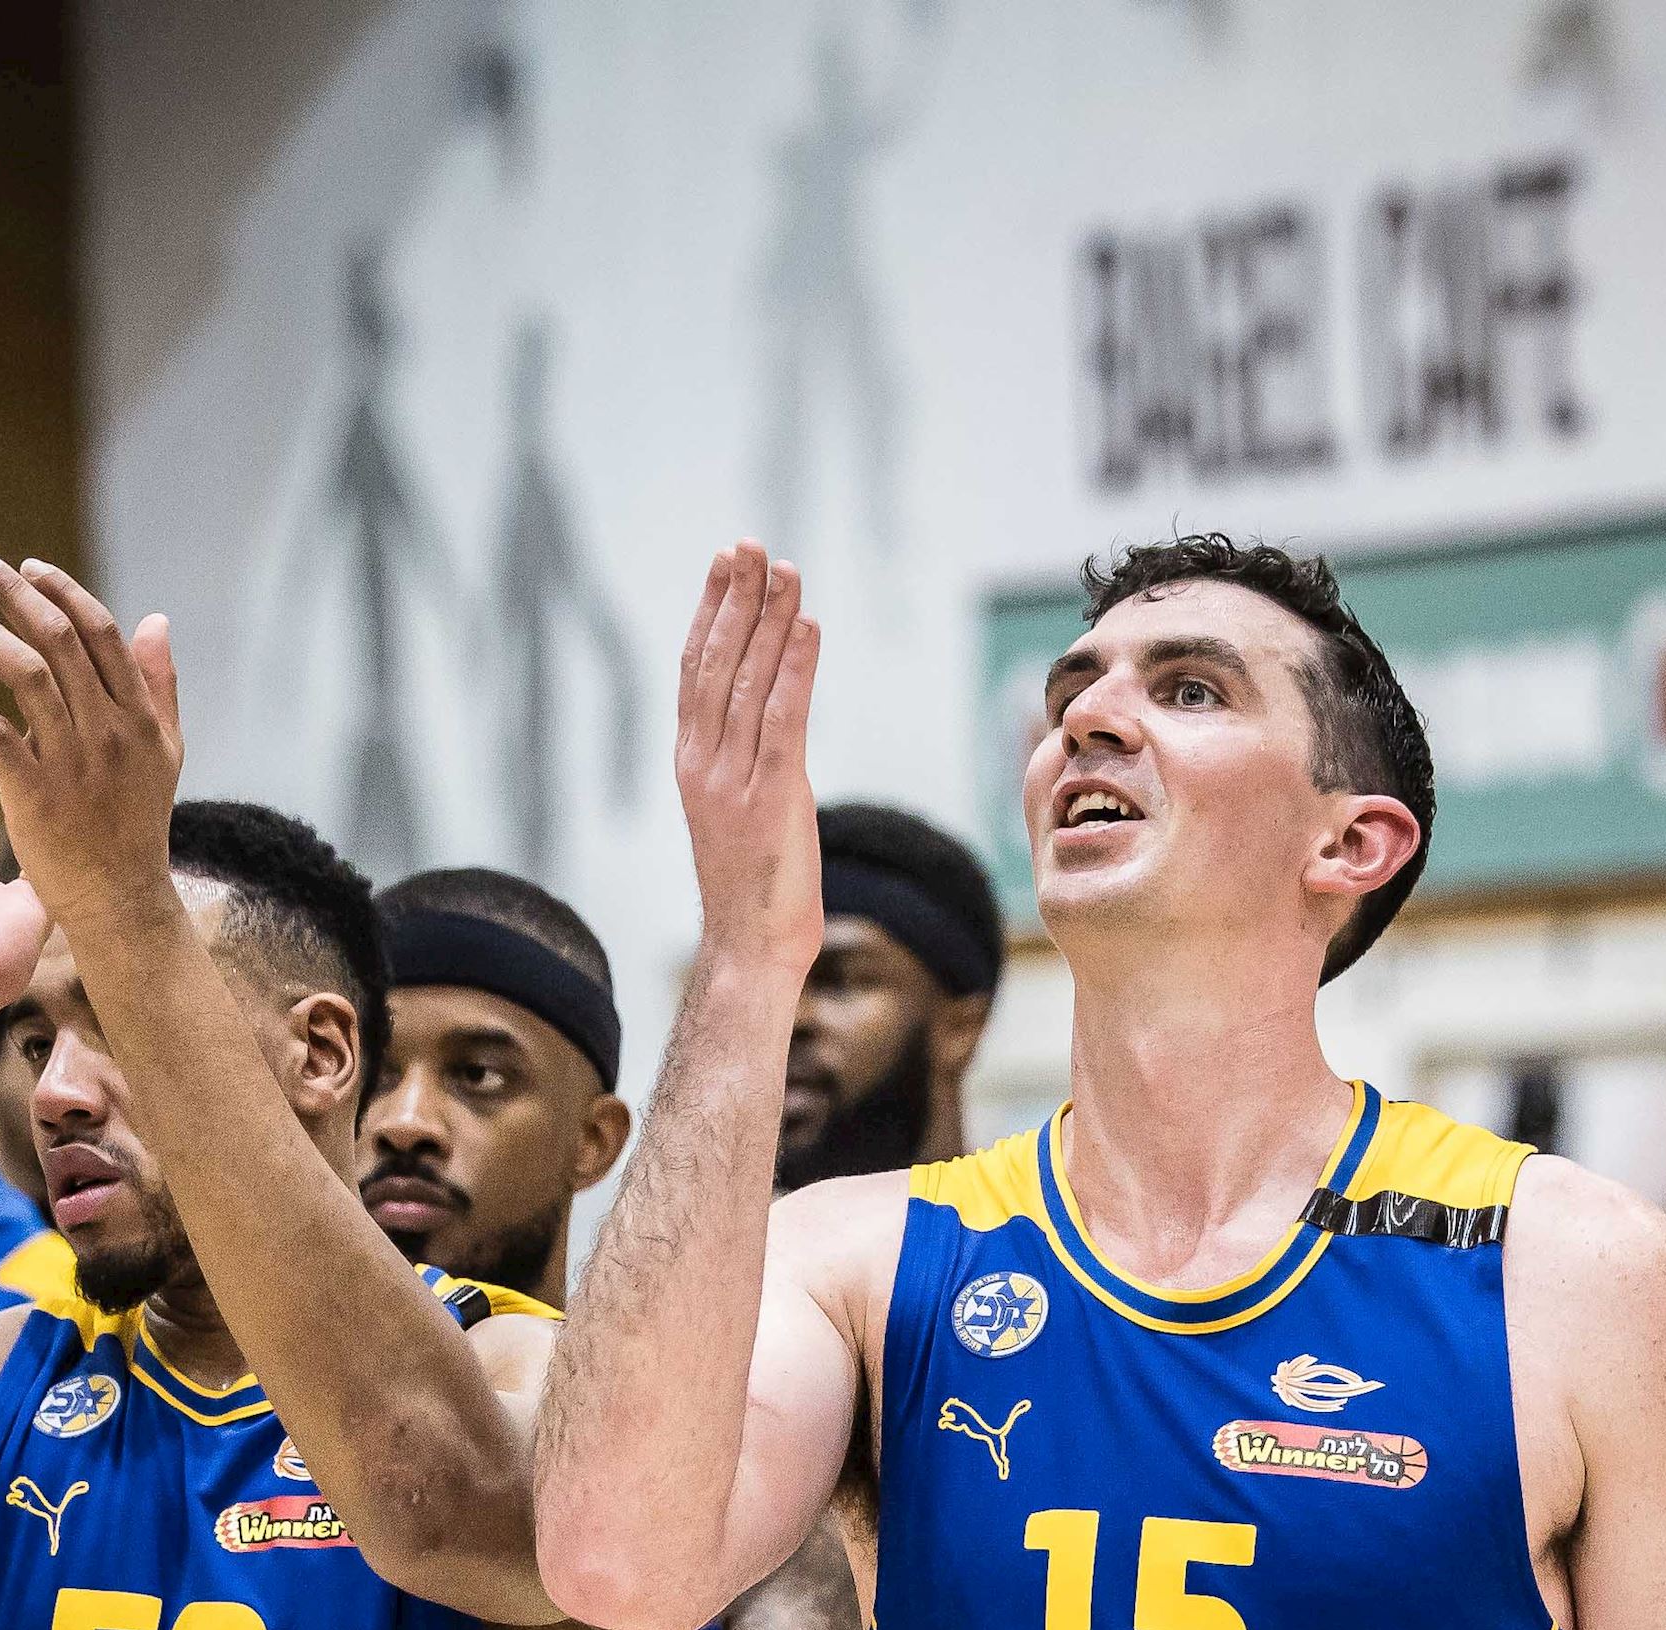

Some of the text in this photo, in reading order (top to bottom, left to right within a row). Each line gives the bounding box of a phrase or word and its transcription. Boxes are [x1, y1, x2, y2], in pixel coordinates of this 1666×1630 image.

[1238, 1434, 1367, 1472] Winner
[1369, 1452, 1400, 1477] סל
[239, 1514, 346, 1543] Winner
